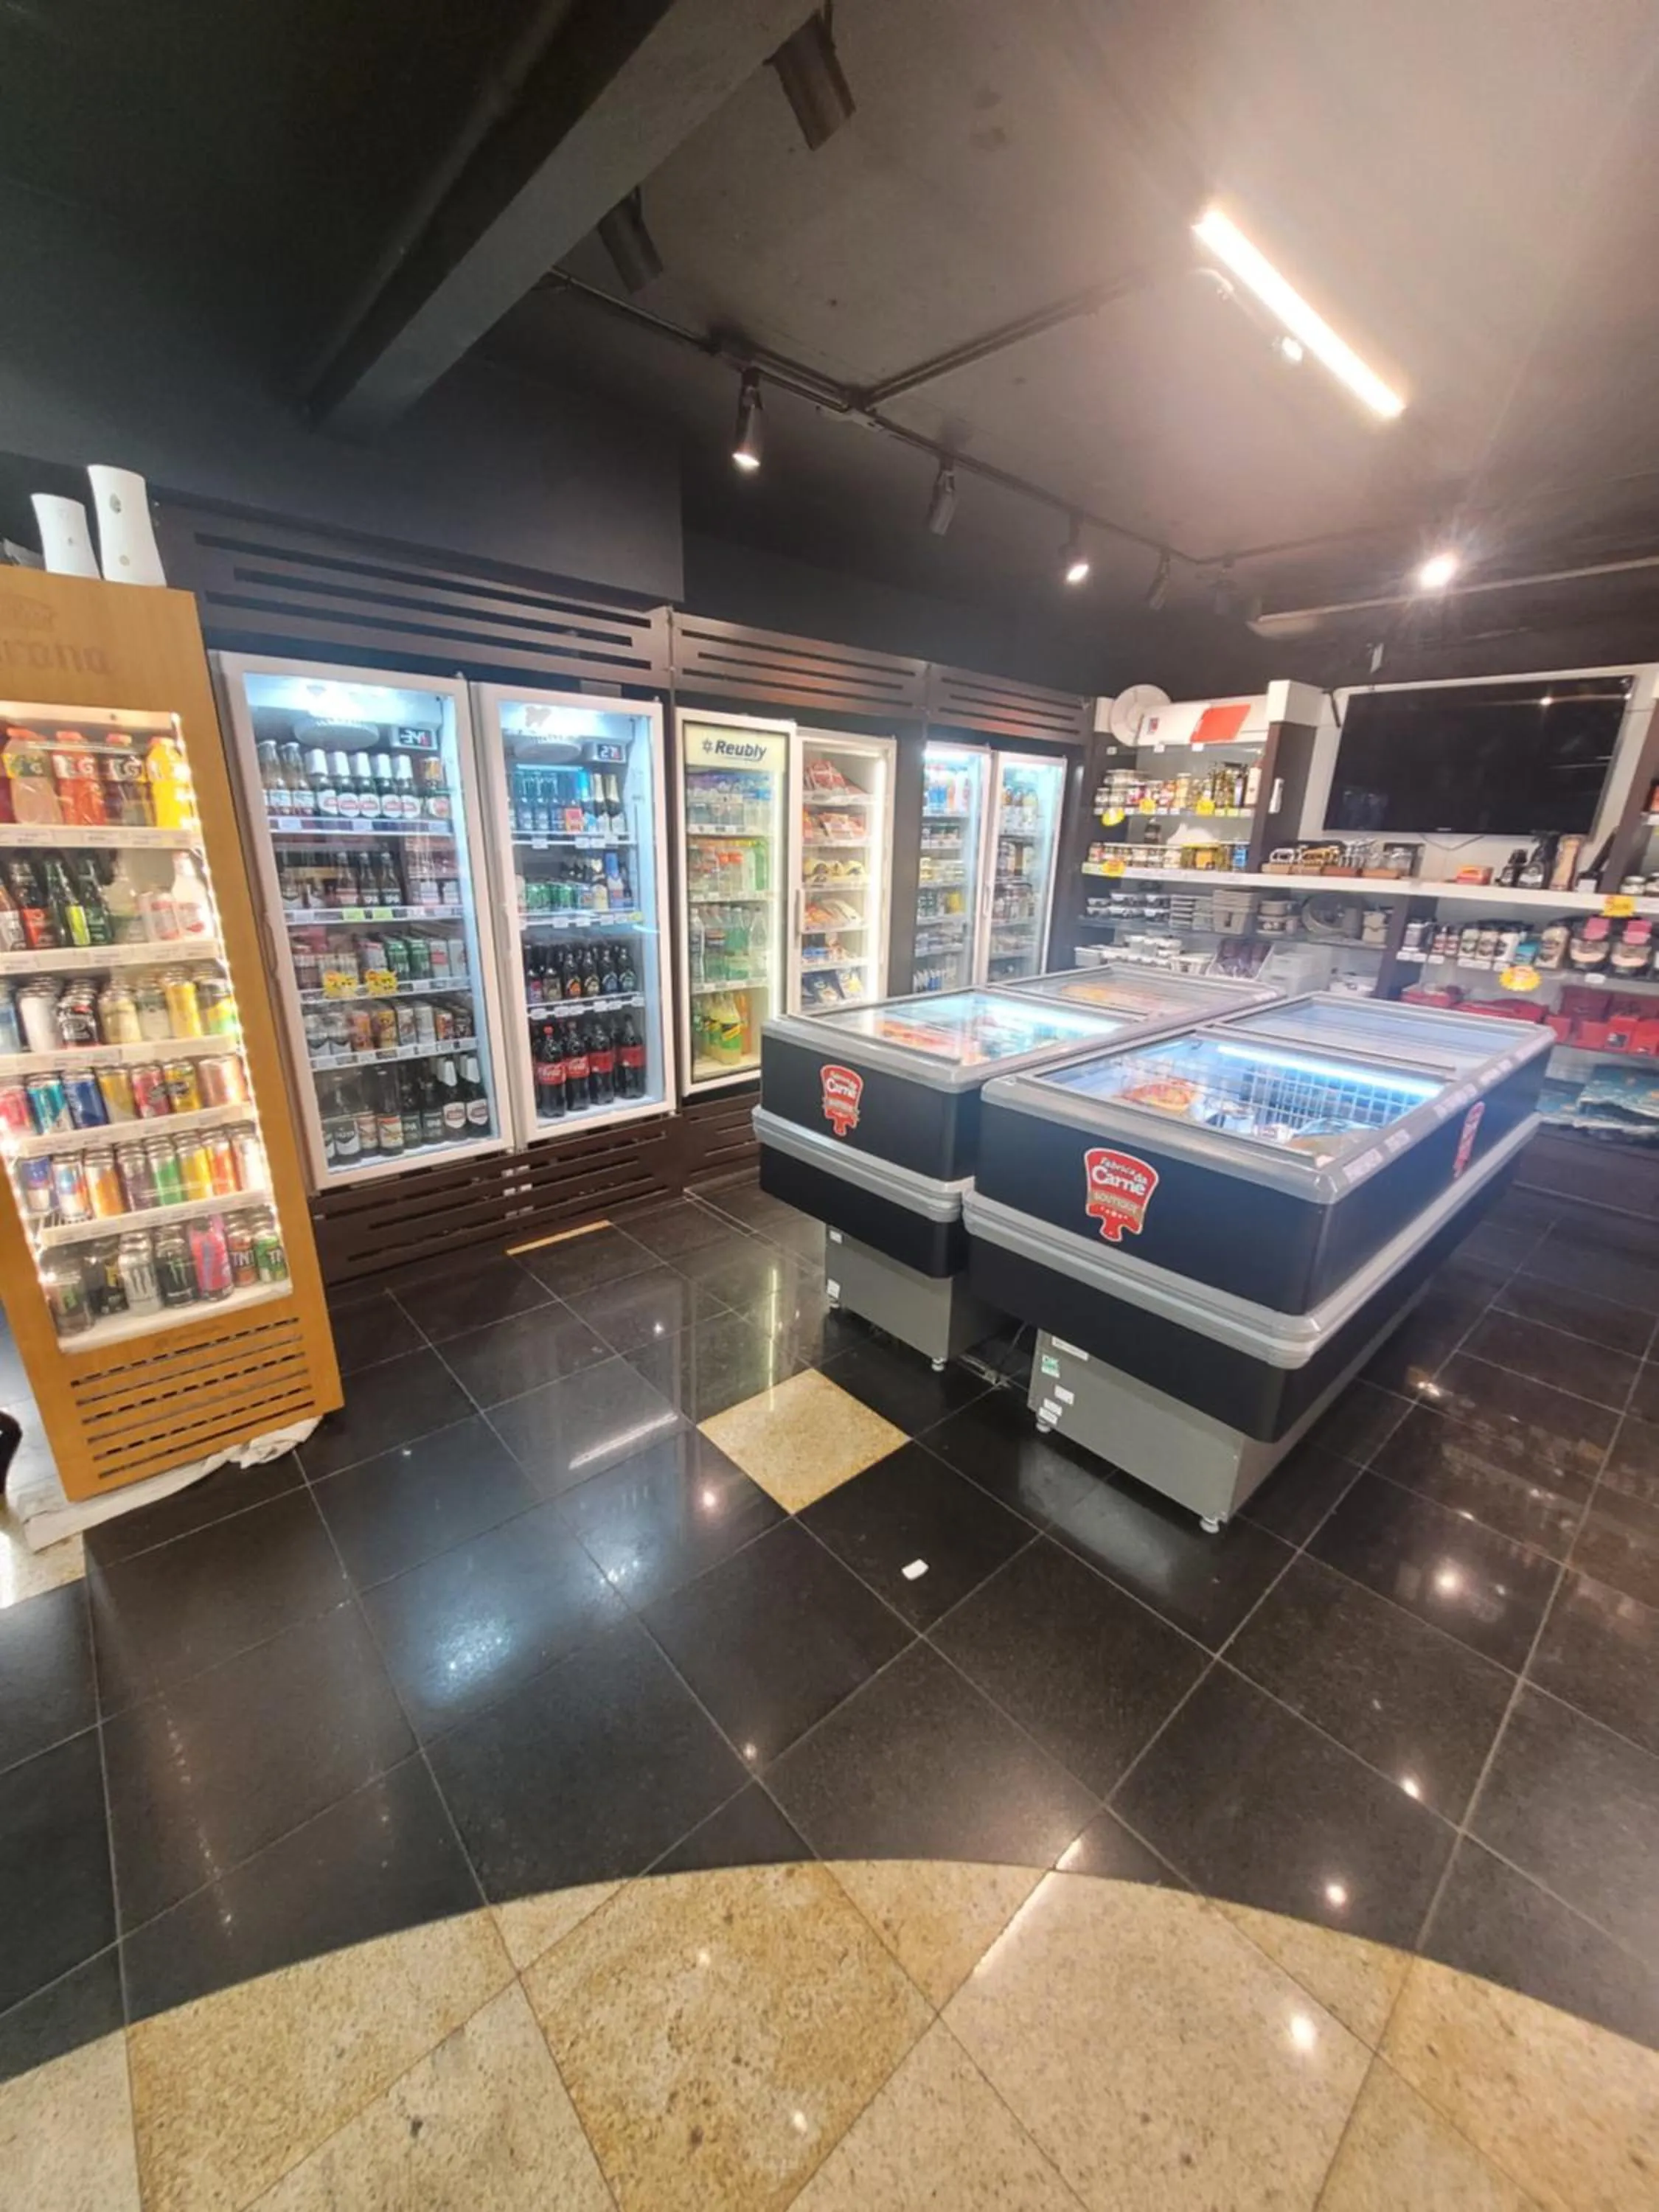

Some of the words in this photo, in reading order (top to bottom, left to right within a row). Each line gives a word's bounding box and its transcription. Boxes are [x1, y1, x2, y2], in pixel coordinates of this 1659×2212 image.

[0, 639, 112, 675] rona
[714, 740, 768, 761] Reubly
[1091, 1165, 1147, 1196] Carne
